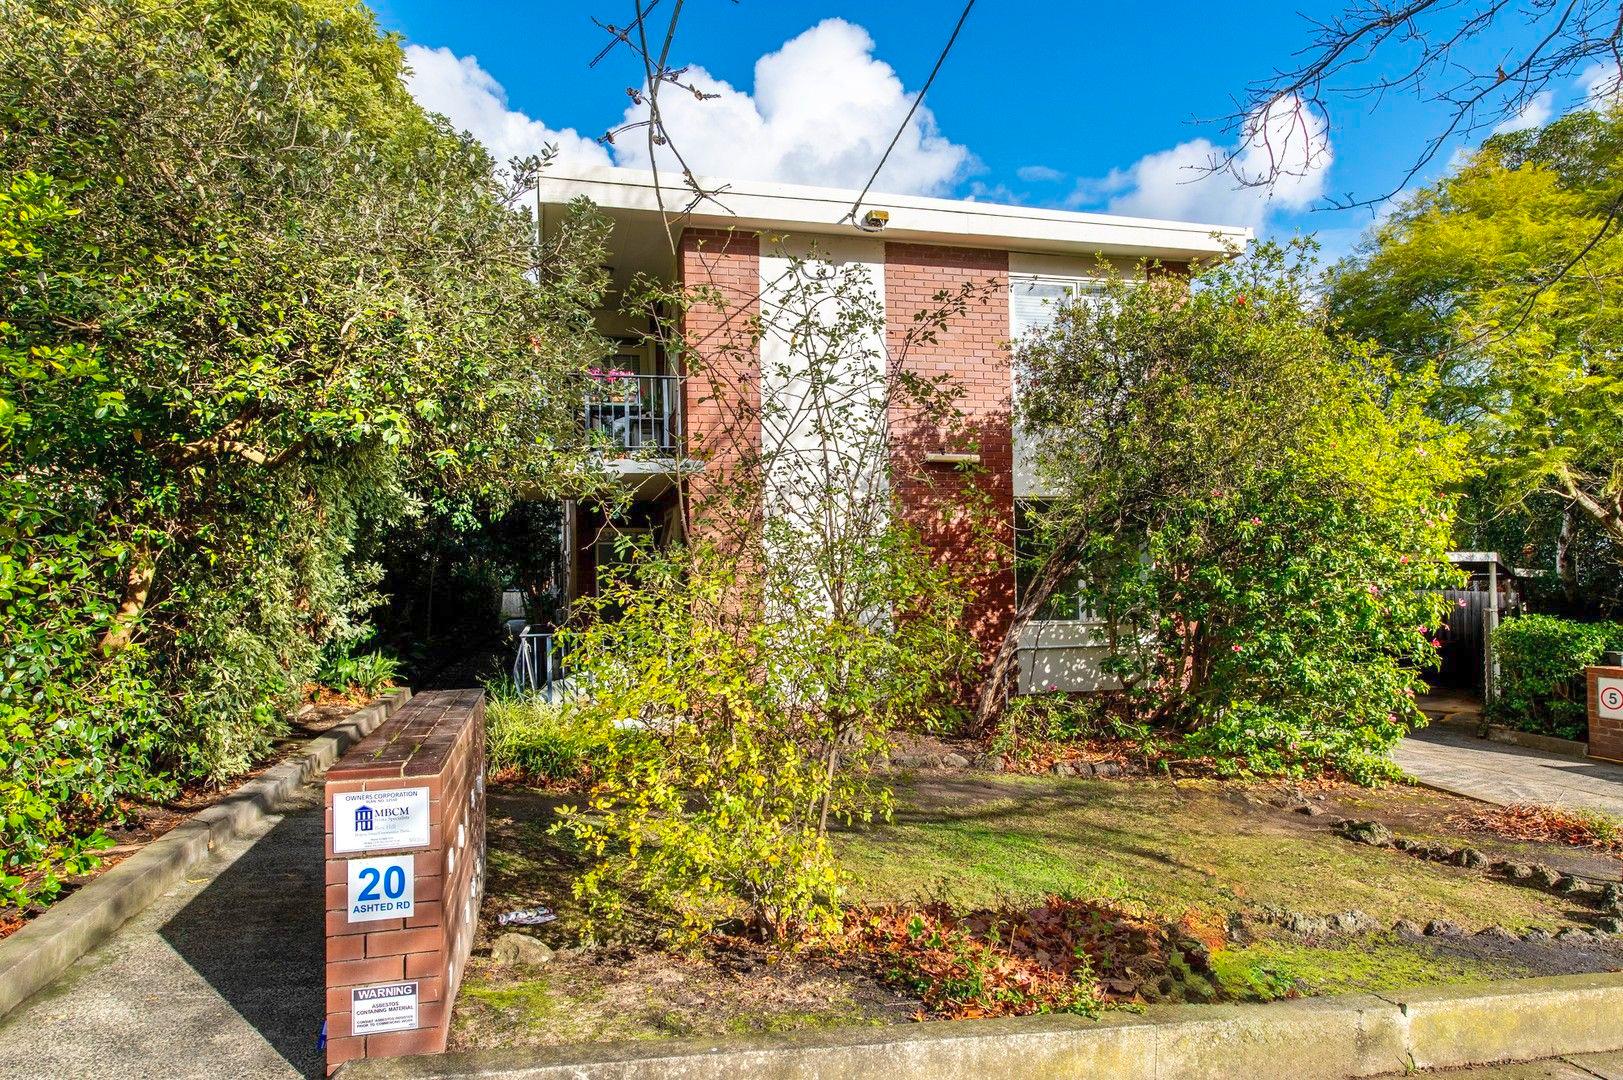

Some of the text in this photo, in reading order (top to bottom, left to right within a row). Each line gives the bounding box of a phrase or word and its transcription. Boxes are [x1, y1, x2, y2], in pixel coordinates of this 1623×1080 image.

[1609, 693, 1617, 704] 5
[374, 791, 418, 799] CORPORATION
[375, 807, 409, 817] MBCM
[358, 866, 405, 901] 20
[353, 901, 410, 913] ASHTED RD
[358, 986, 412, 999] WARNING
